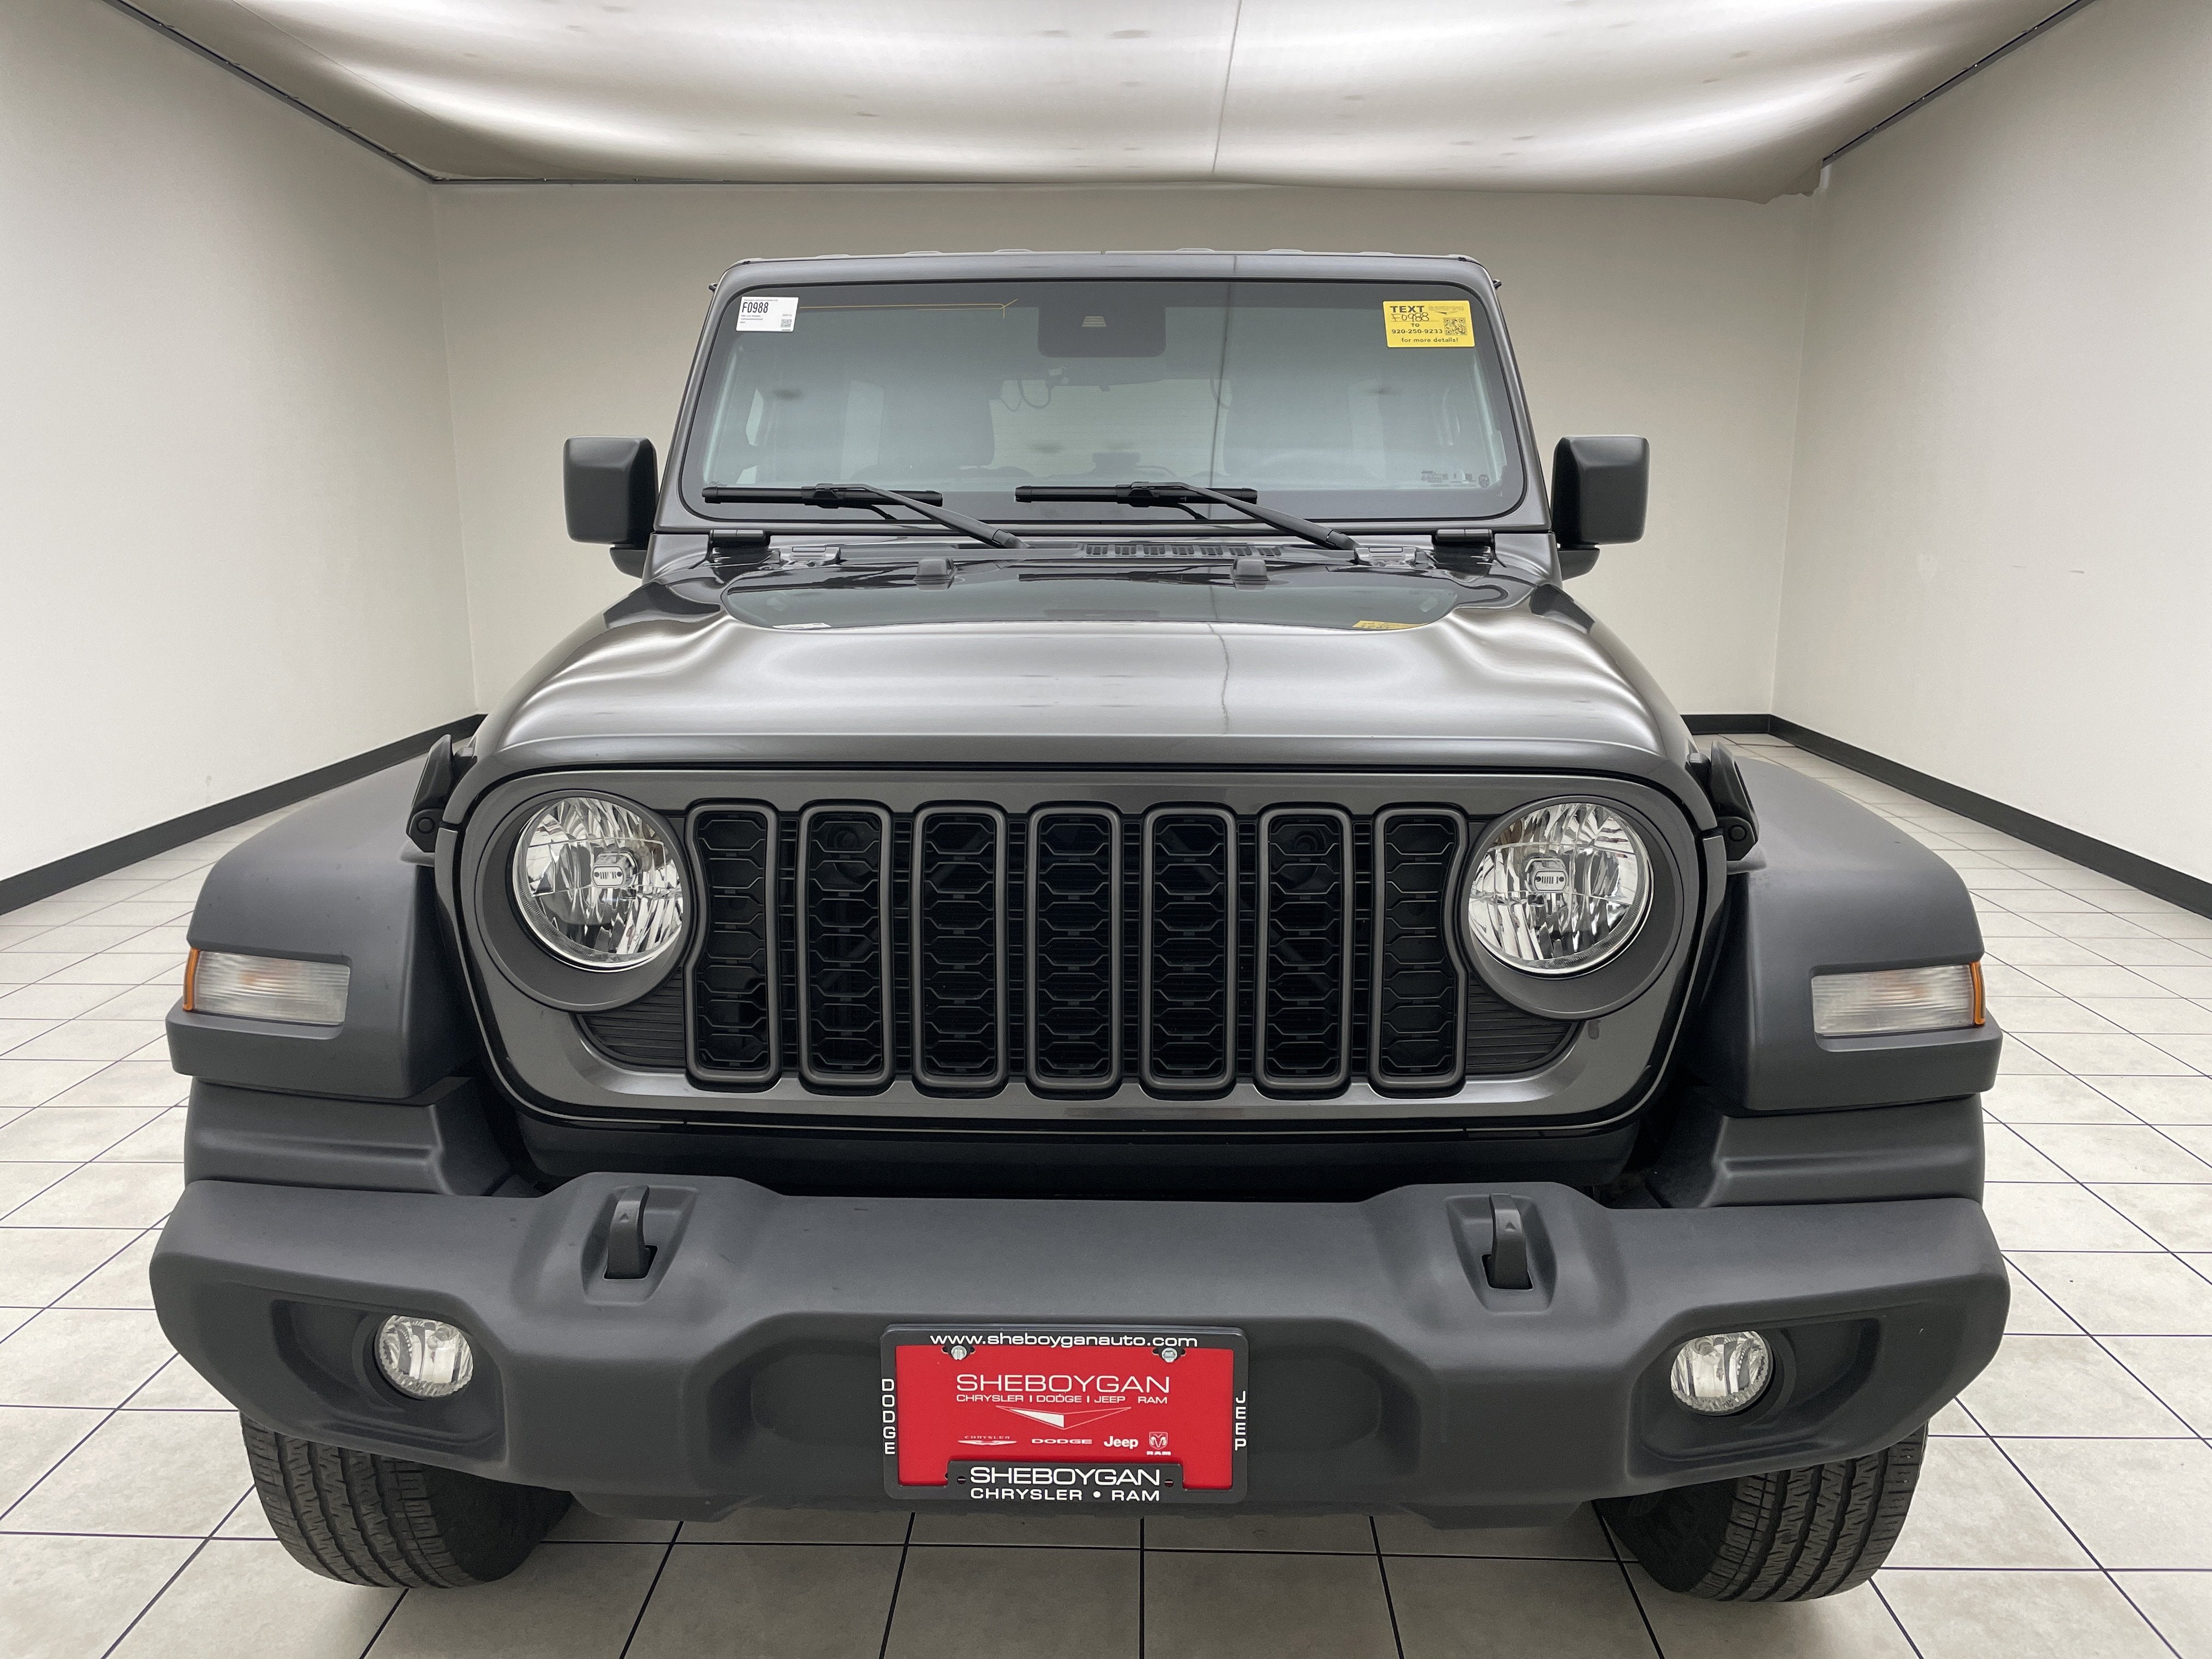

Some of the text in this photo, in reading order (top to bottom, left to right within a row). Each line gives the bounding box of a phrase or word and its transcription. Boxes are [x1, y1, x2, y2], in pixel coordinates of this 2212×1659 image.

[742, 302, 769, 313] F0988
[1391, 312, 1430, 322] F0988
[930, 1333, 1198, 1348] www.sheboyganauto.com
[956, 1374, 1170, 1393] SHEBOYGAN
[956, 1394, 1024, 1403] CHRYSLER
[1036, 1394, 1082, 1403] DODGE
[1093, 1395, 1126, 1403] JEEP
[881, 1378, 896, 1455] DODGE
[1234, 1390, 1247, 1451] JEEP
[1103, 1435, 1139, 1449] Jeep
[970, 1466, 1160, 1486] SHEBOYGAN
[970, 1487, 1160, 1502] CHRYSLER RAM
